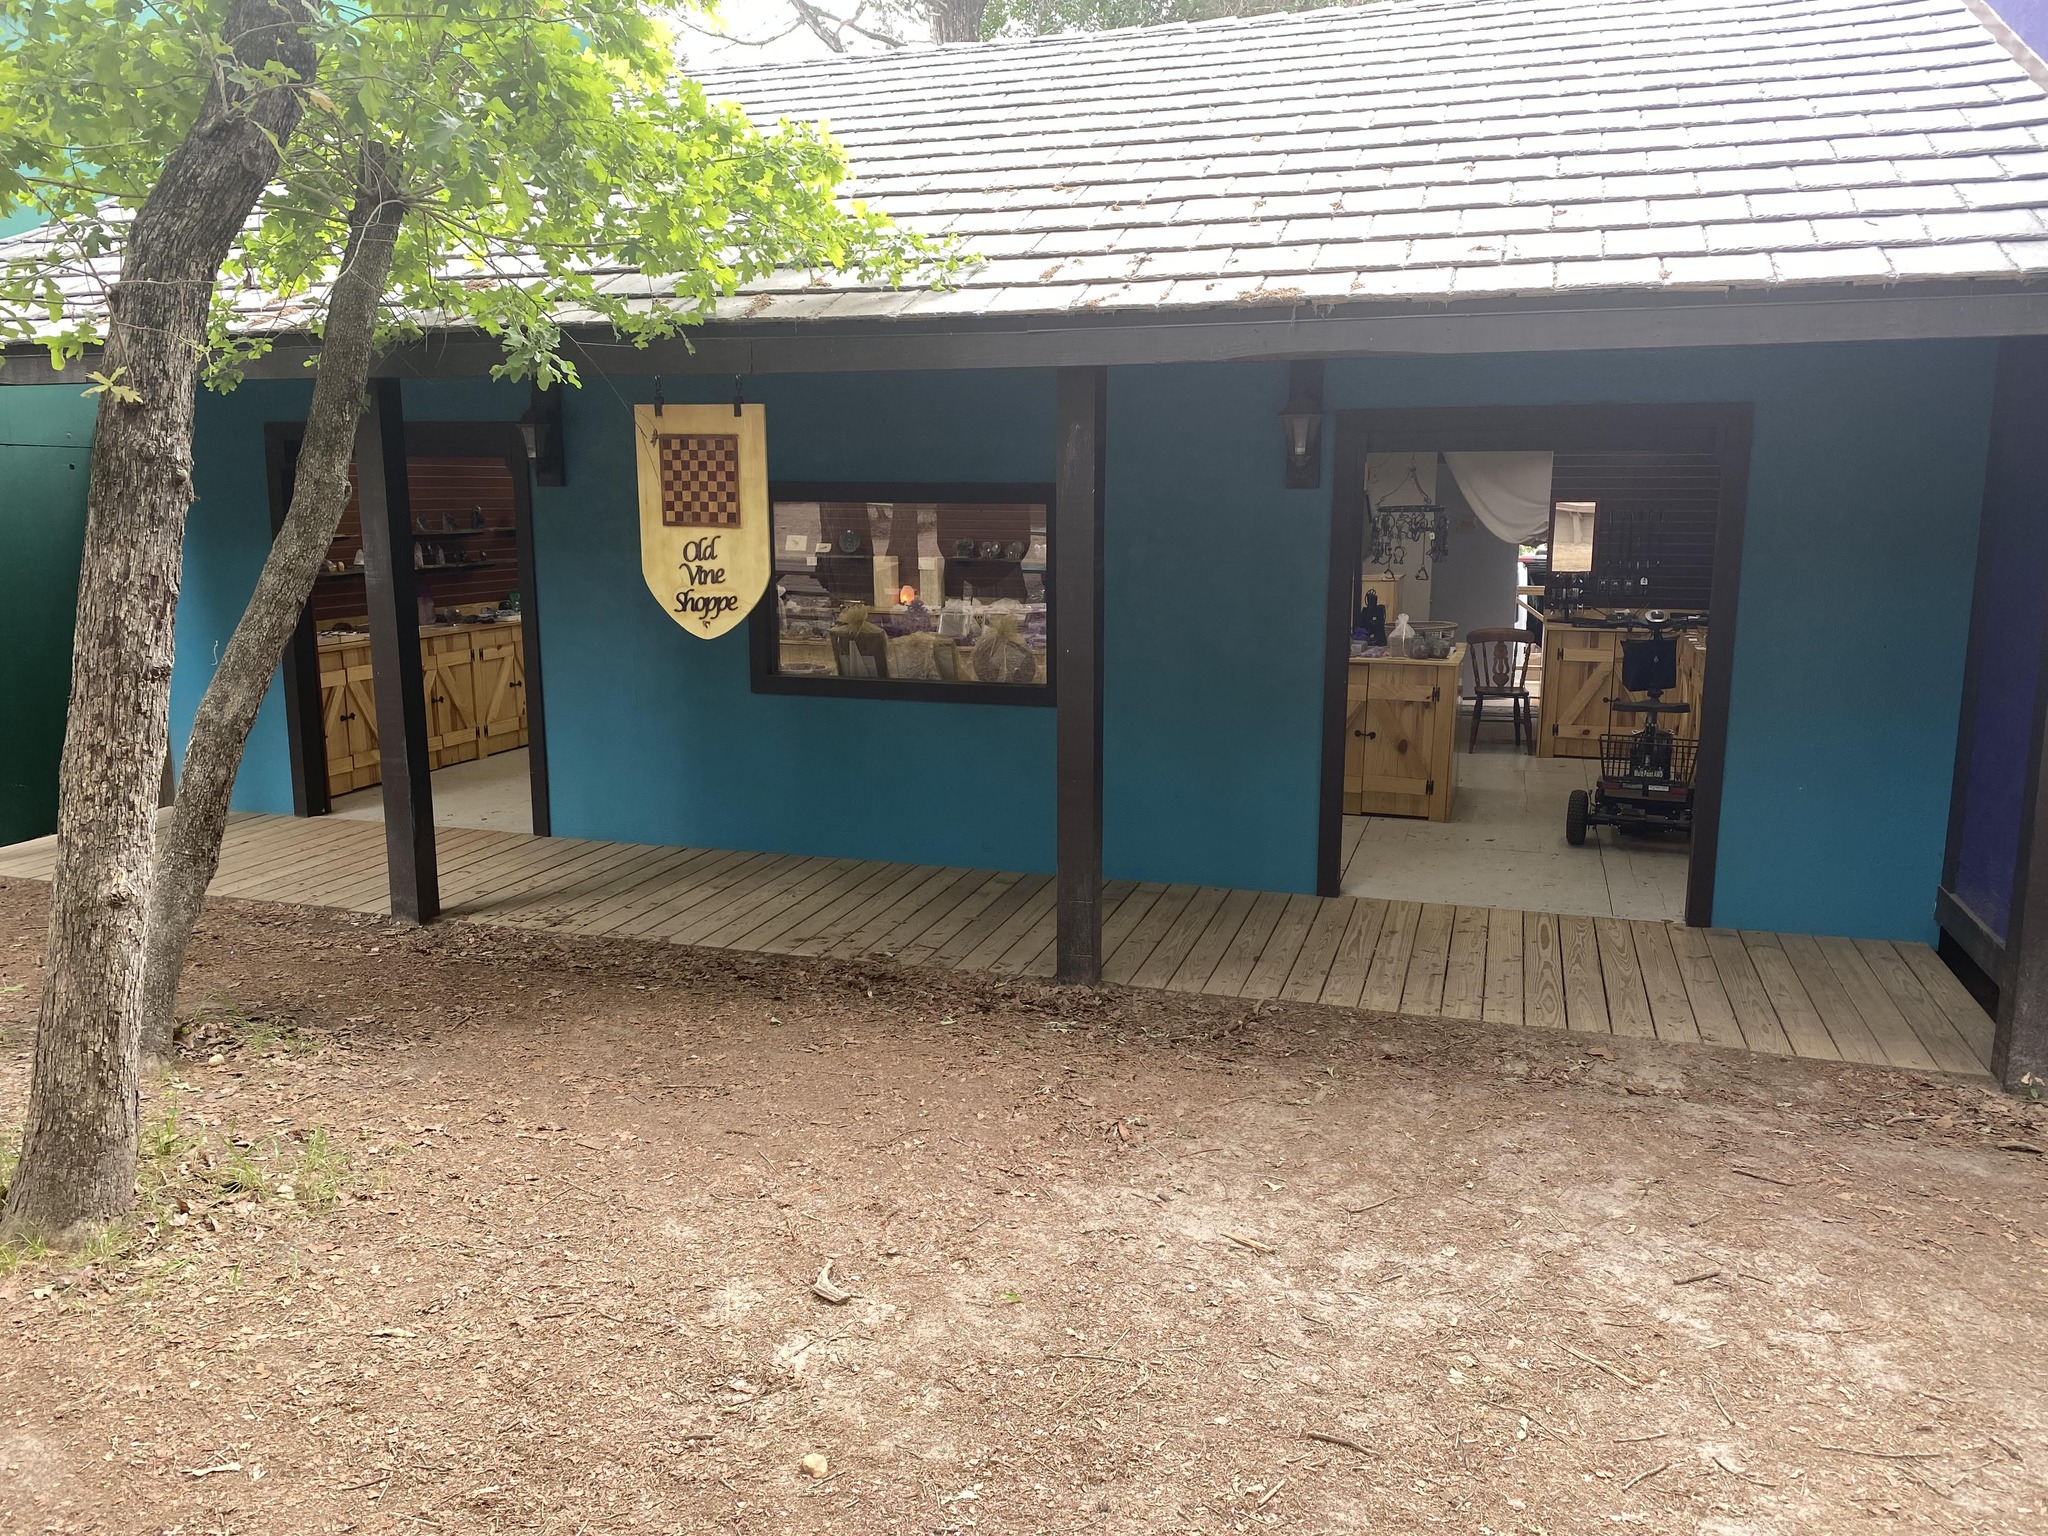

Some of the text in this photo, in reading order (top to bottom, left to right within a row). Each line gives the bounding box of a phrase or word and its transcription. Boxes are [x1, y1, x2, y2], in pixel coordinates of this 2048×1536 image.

[683, 535, 721, 562] Old
[679, 563, 726, 586] Vine
[674, 589, 739, 620] Shoppe
